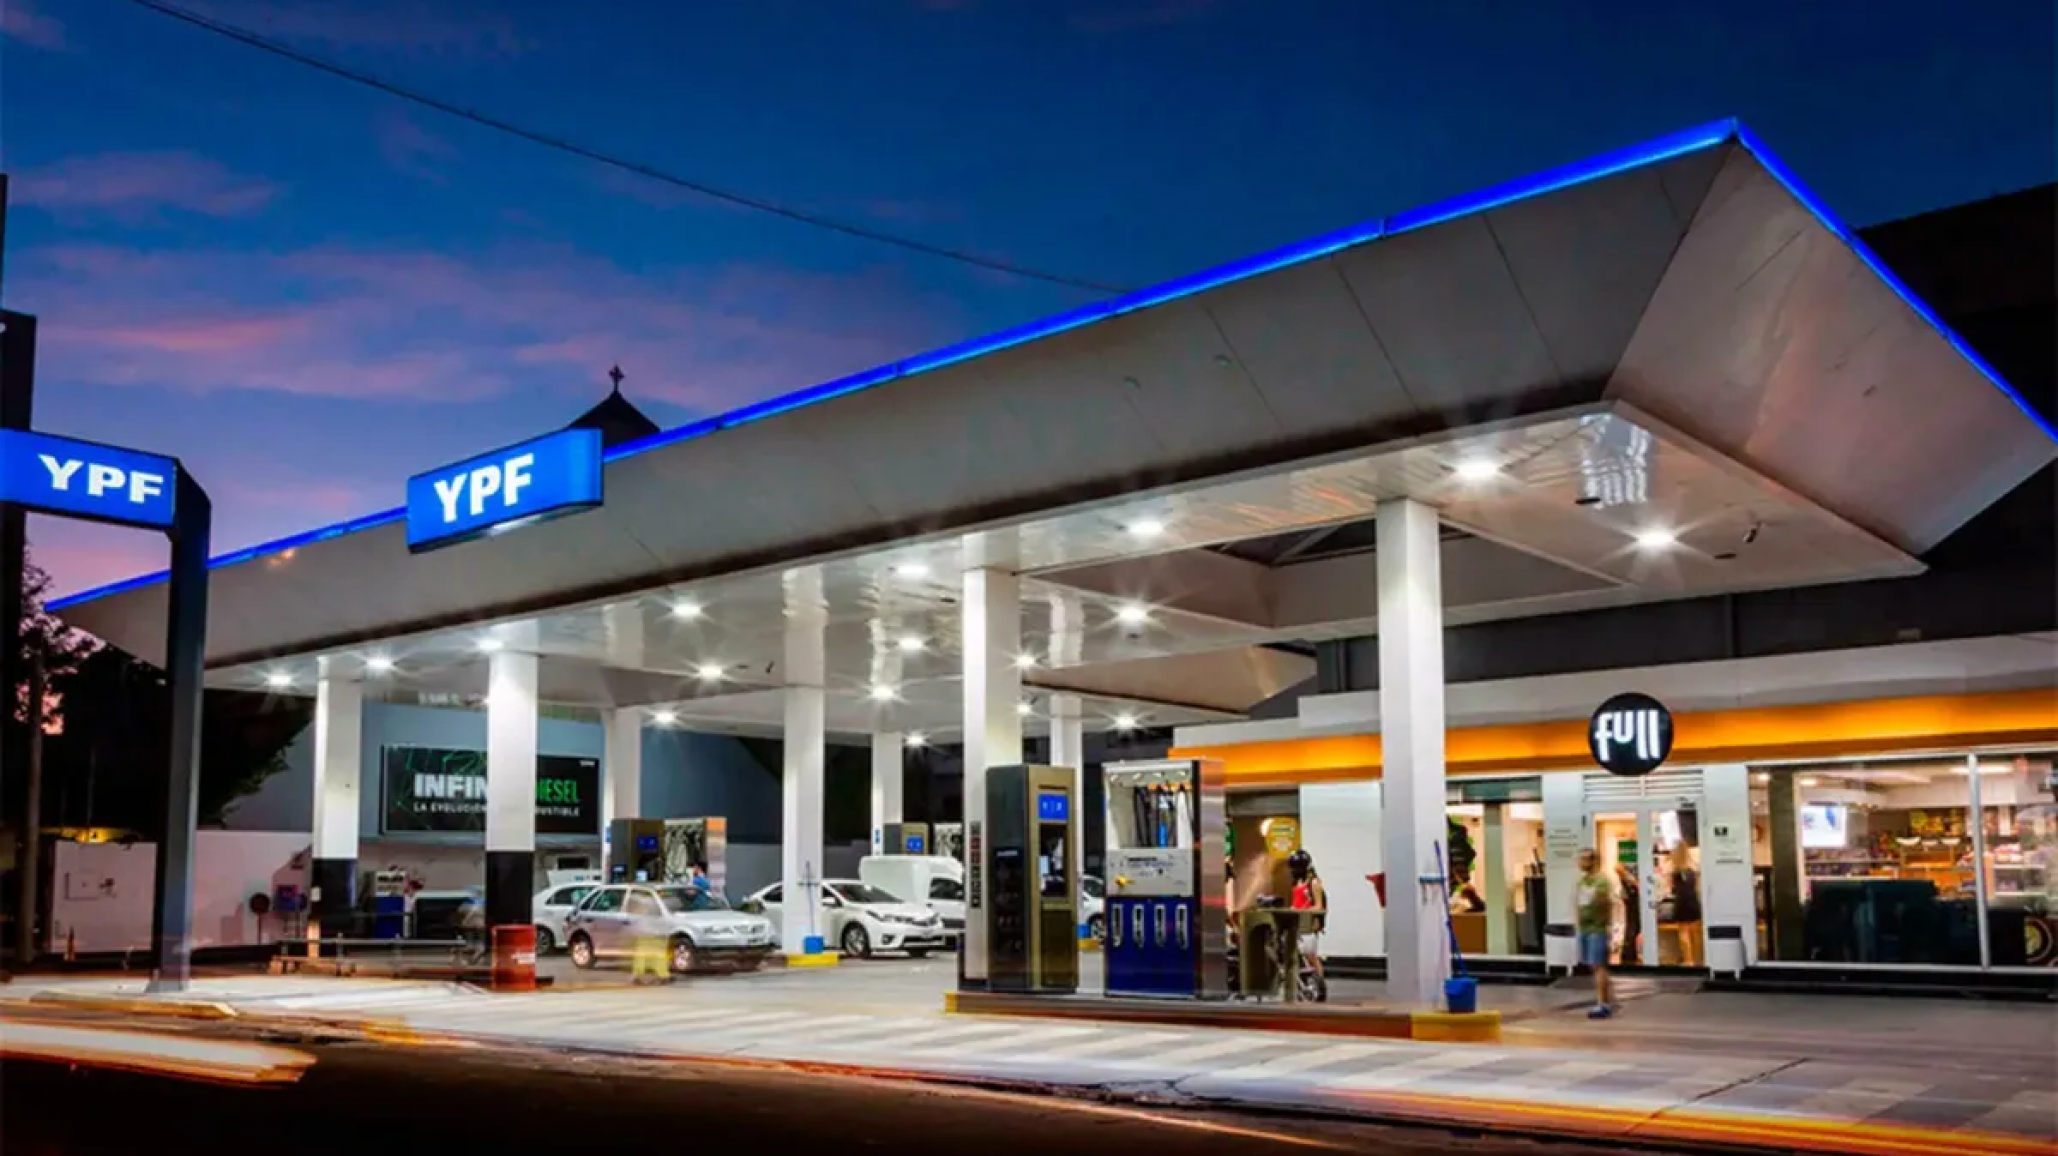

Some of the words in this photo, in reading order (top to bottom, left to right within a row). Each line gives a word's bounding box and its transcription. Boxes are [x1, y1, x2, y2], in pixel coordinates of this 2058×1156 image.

[38, 453, 164, 504] YPF
[433, 453, 534, 523] YPF
[414, 773, 488, 799] INFIN
[413, 802, 428, 813] LA
